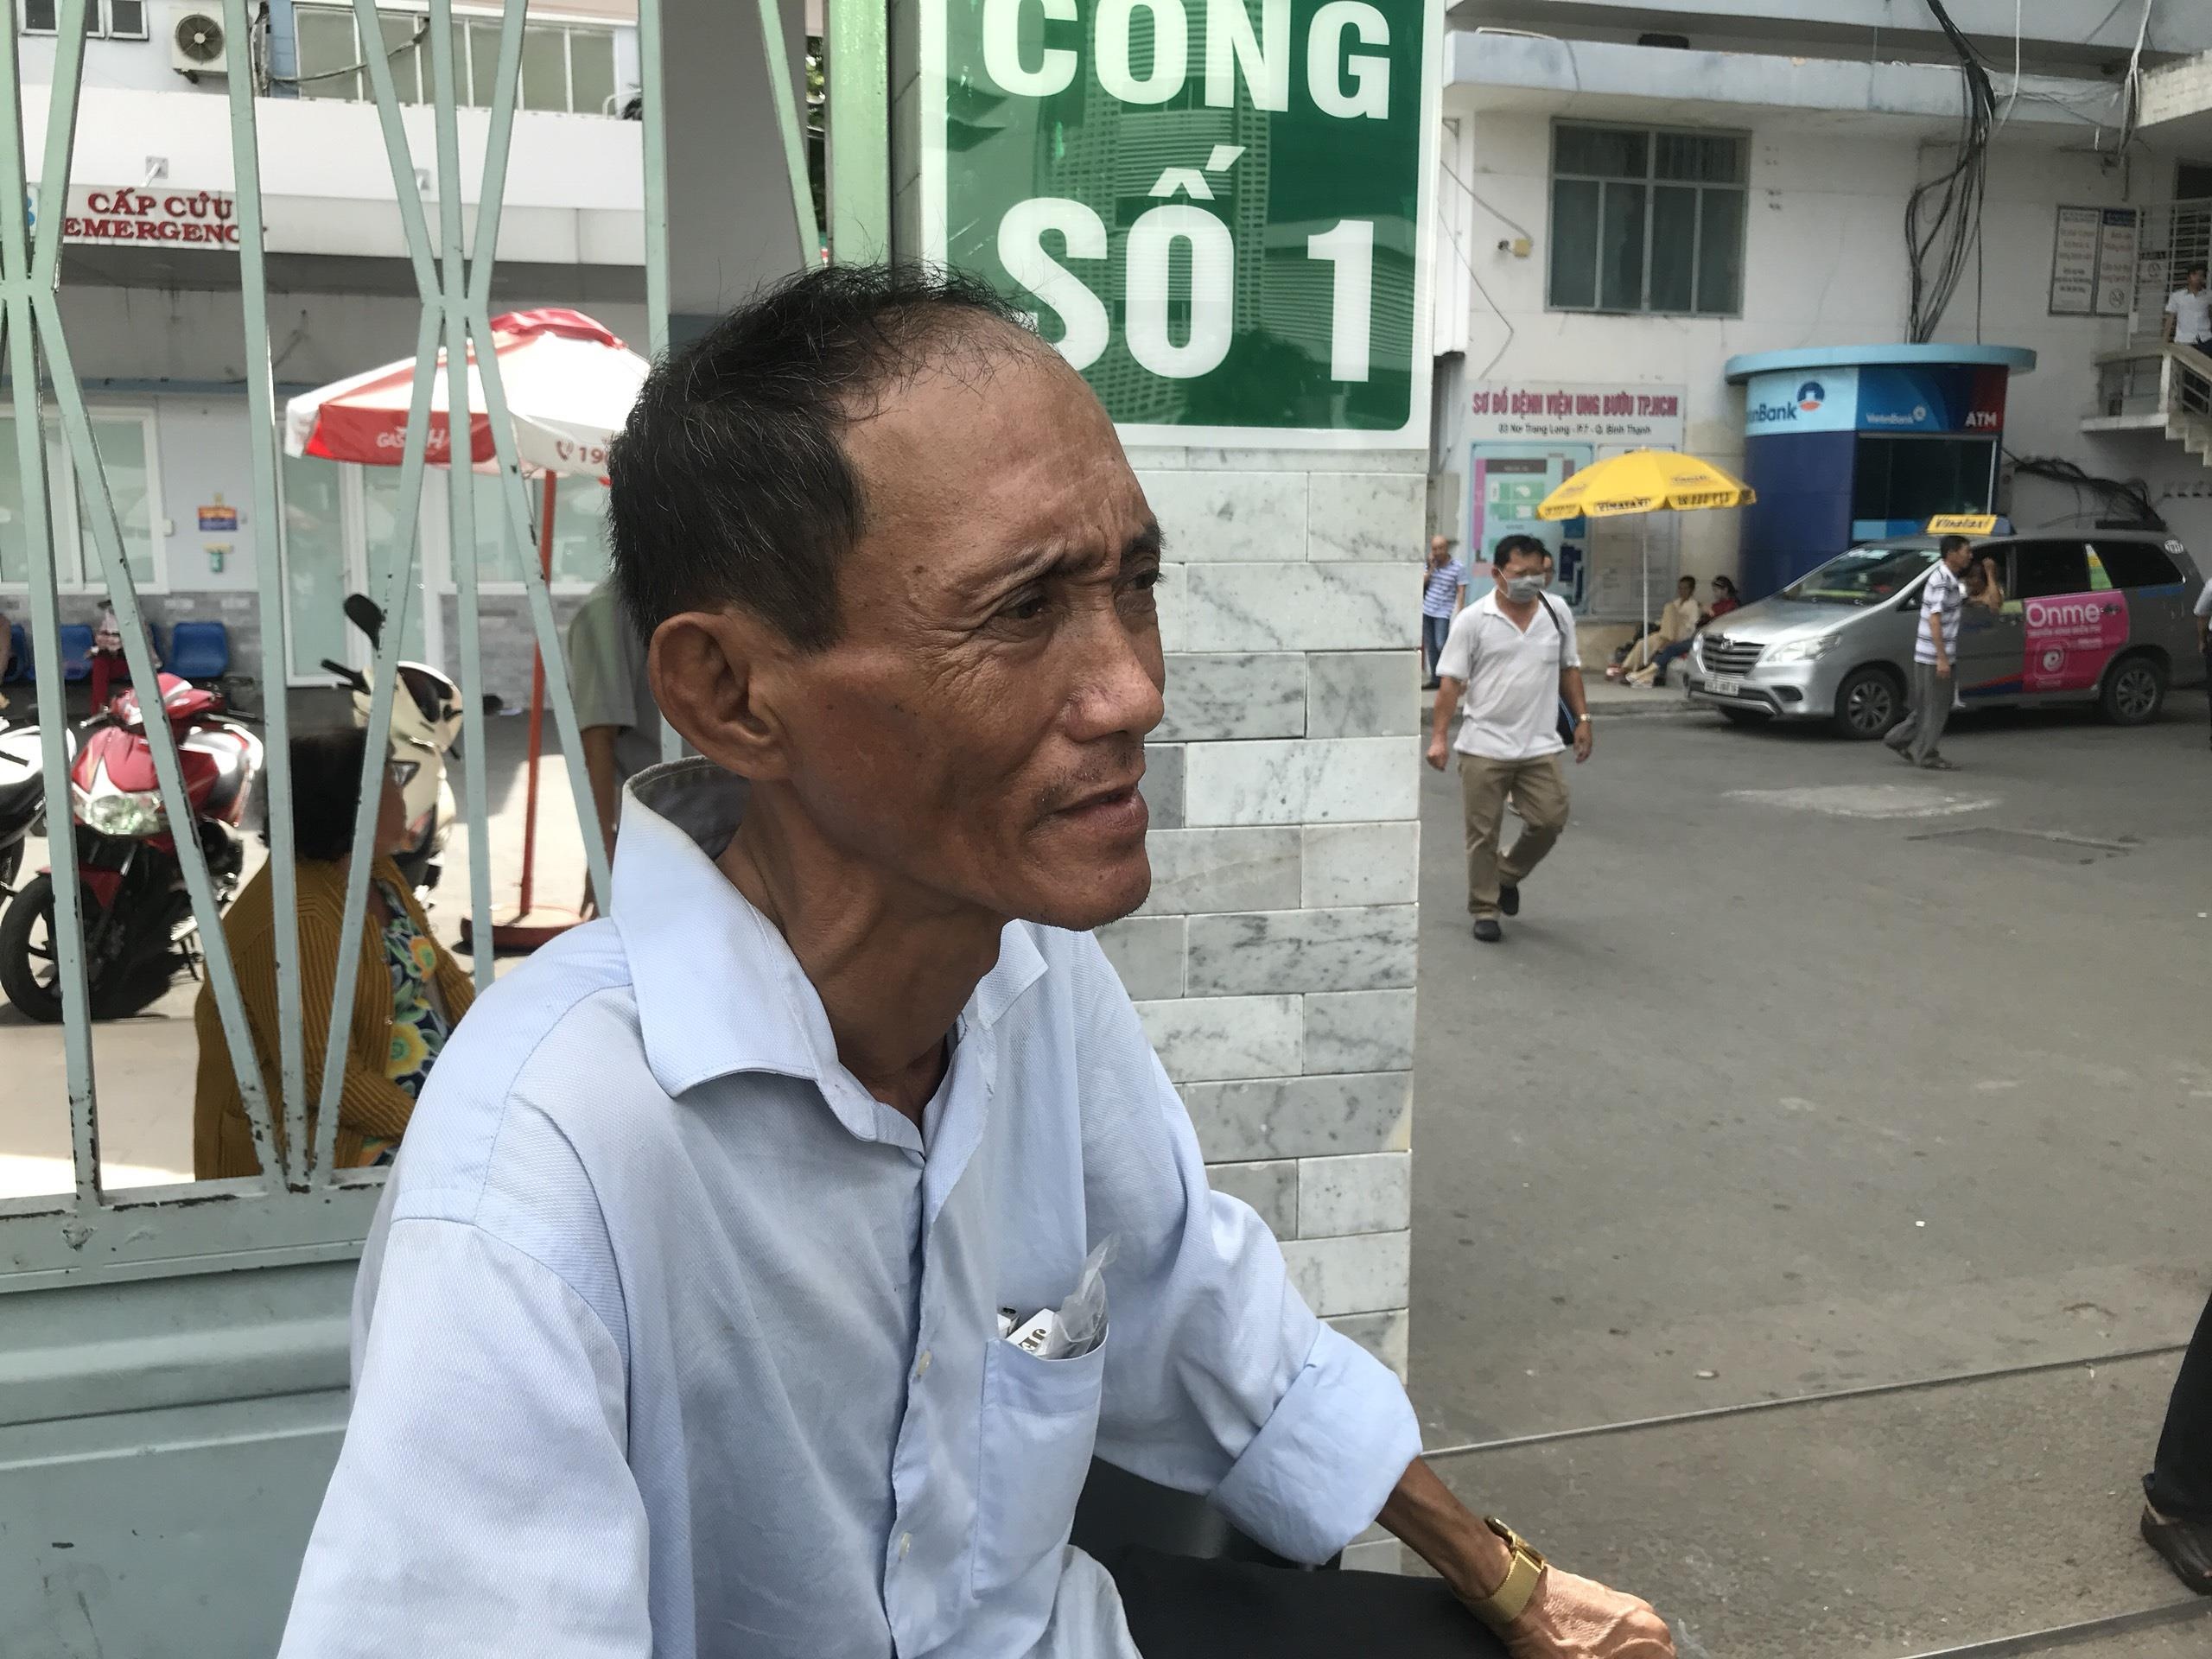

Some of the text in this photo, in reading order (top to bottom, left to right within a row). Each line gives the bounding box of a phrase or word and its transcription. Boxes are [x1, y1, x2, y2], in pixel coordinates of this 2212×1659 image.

[87, 187, 157, 216] CẤP
[64, 217, 268, 244] EMERGENC
[996, 144, 1374, 383] SỐ 1
[1511, 389, 1542, 419] BỆNH
[1547, 389, 1573, 420] VIỆN
[1965, 410, 1997, 428] ATM
[2025, 602, 2101, 628] Onme
